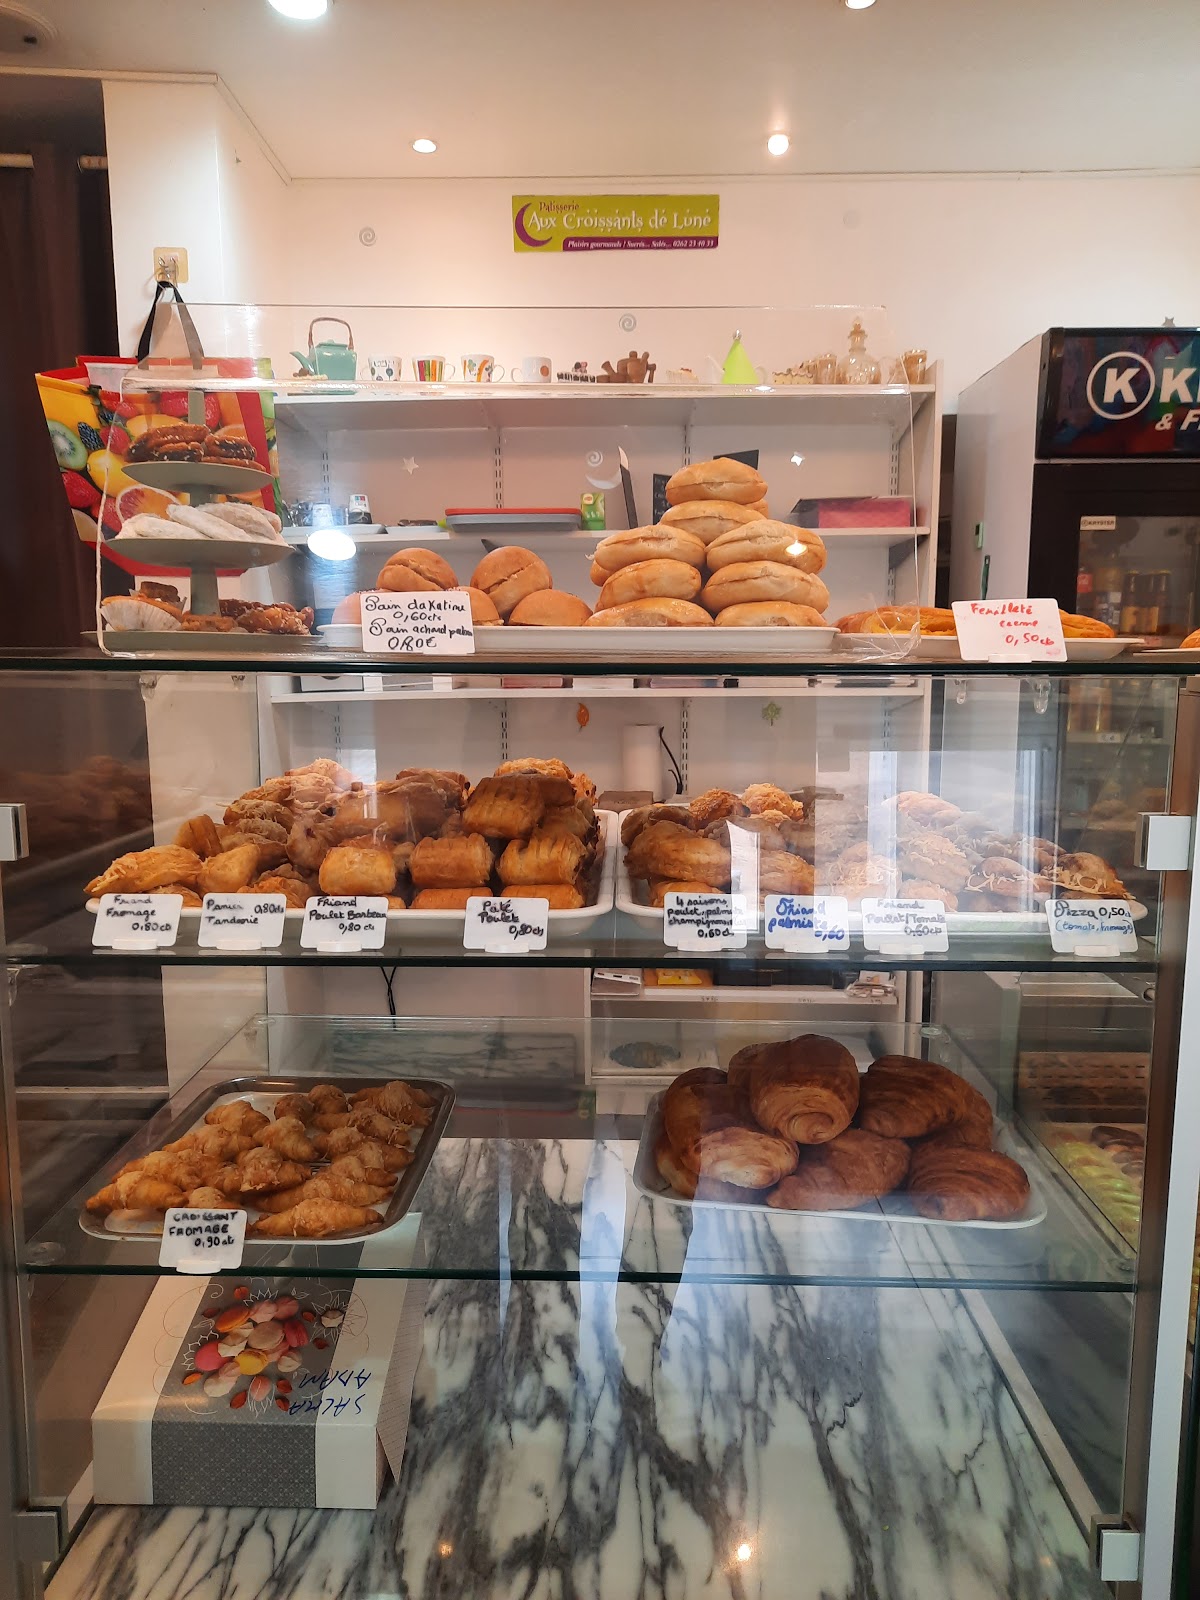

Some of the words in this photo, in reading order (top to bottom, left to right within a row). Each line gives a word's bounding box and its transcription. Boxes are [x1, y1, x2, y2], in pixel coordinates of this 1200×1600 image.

[528, 210, 557, 231] Aux
[562, 208, 644, 233] Croissants
[1103, 368, 1140, 403] K
[1159, 367, 1200, 403] K
[1180, 409, 1200, 431] F
[106, 907, 156, 921] Fromage
[309, 909, 345, 920] Poulet
[478, 911, 519, 923] Poulet
[1054, 900, 1098, 919] Pizza
[168, 1224, 229, 1237] FROMAGE
